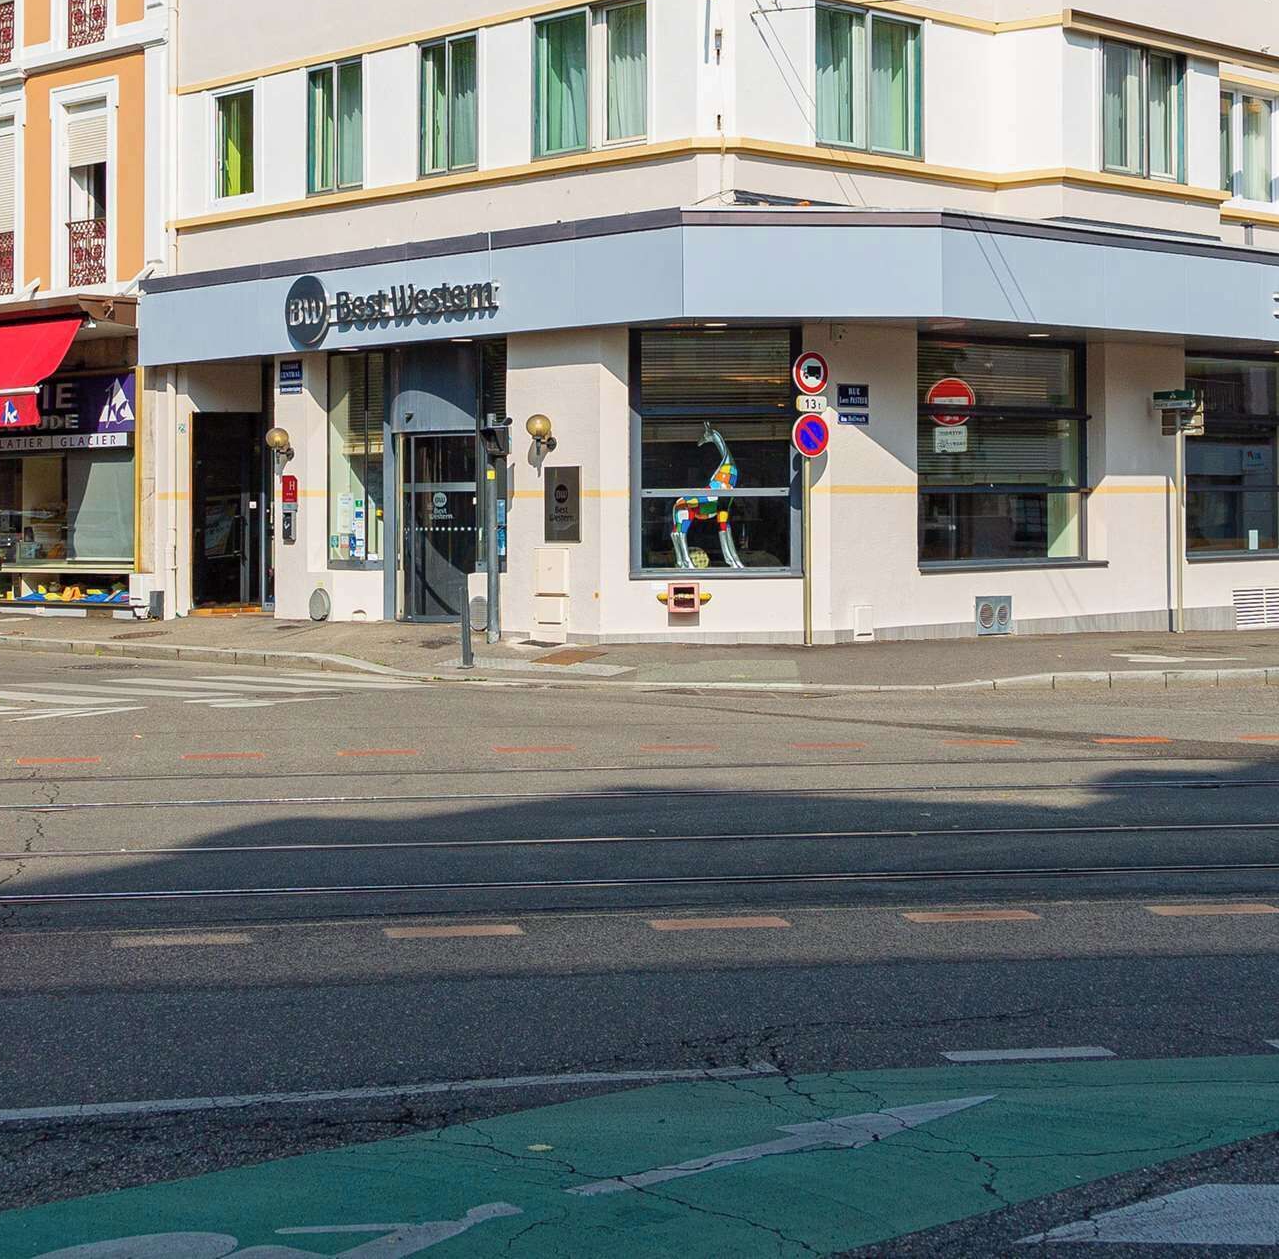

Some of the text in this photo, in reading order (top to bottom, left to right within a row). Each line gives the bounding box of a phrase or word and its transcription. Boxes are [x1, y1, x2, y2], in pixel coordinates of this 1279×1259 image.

[289, 281, 495, 326] BW Best Western
[805, 399, 817, 409] 13
[60, 434, 118, 448] GLACIER
